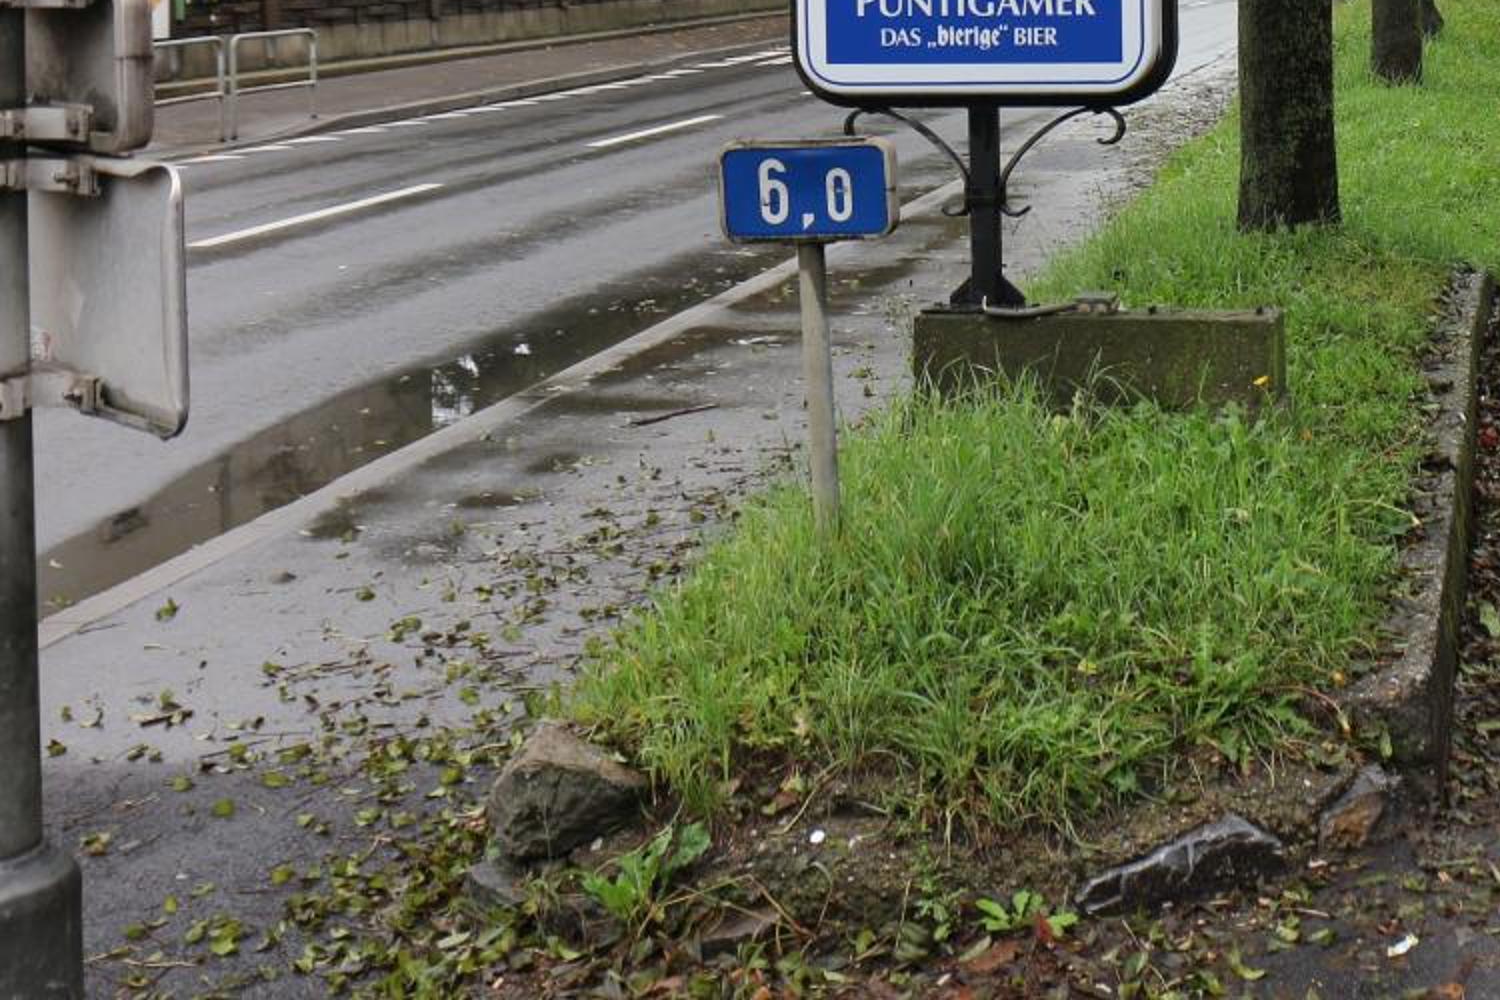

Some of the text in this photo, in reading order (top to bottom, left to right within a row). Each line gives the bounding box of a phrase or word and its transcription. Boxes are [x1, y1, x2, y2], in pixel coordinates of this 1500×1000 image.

[881, 27, 921, 47] DAS
[1014, 27, 1058, 46] BIER
[758, 157, 853, 230] 6,0
